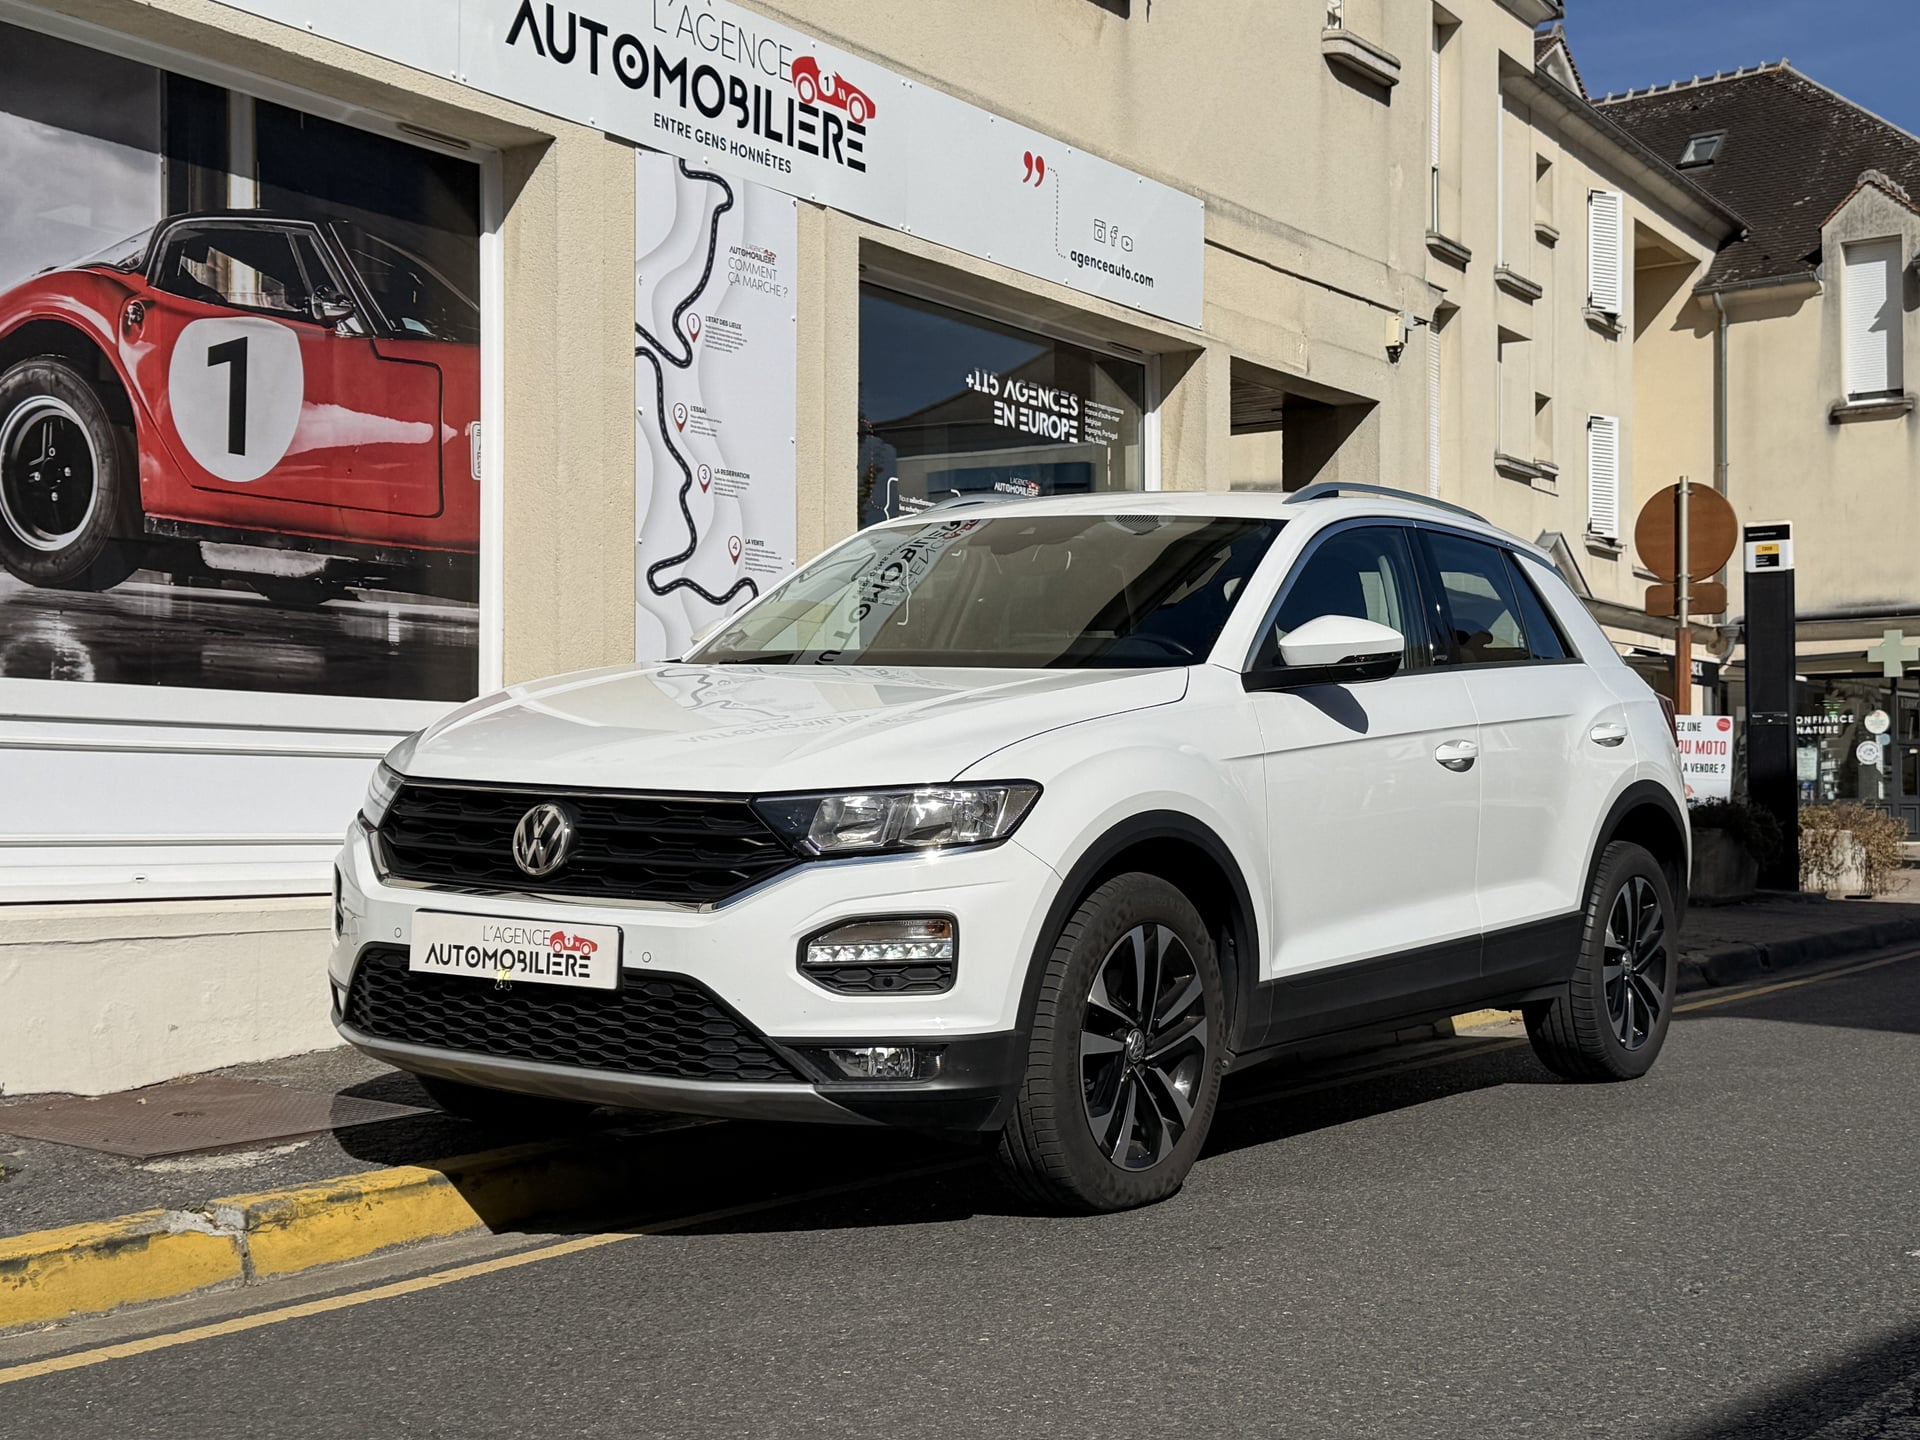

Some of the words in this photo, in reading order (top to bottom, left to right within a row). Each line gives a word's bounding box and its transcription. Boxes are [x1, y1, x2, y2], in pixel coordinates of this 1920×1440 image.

[654, 113, 692, 140] ENTRE
[695, 129, 728, 152] GENS
[730, 140, 792, 174] HONNÊTES
[728, 257, 778, 281] COMMENT
[1070, 250, 1154, 288] agenceauto.com
[728, 271, 741, 286] ÇA
[742, 275, 781, 297] MARCHE
[783, 286, 789, 298] ?
[208, 336, 248, 456] 1
[1003, 377, 1079, 417] AGENCES
[678, 407, 684, 419] 2
[994, 400, 1016, 429] EN
[1019, 407, 1079, 443] EUROPE
[702, 469, 707, 480] 3
[1687, 722, 1701, 732] UNE
[1795, 714, 1854, 725] ONFIANCE
[1796, 726, 1839, 735] NATURE
[1695, 740, 1726, 755] MOTO
[1683, 763, 1688, 772] A
[1690, 763, 1719, 773] VENDRE
[483, 925, 550, 947] L'AGENCE
